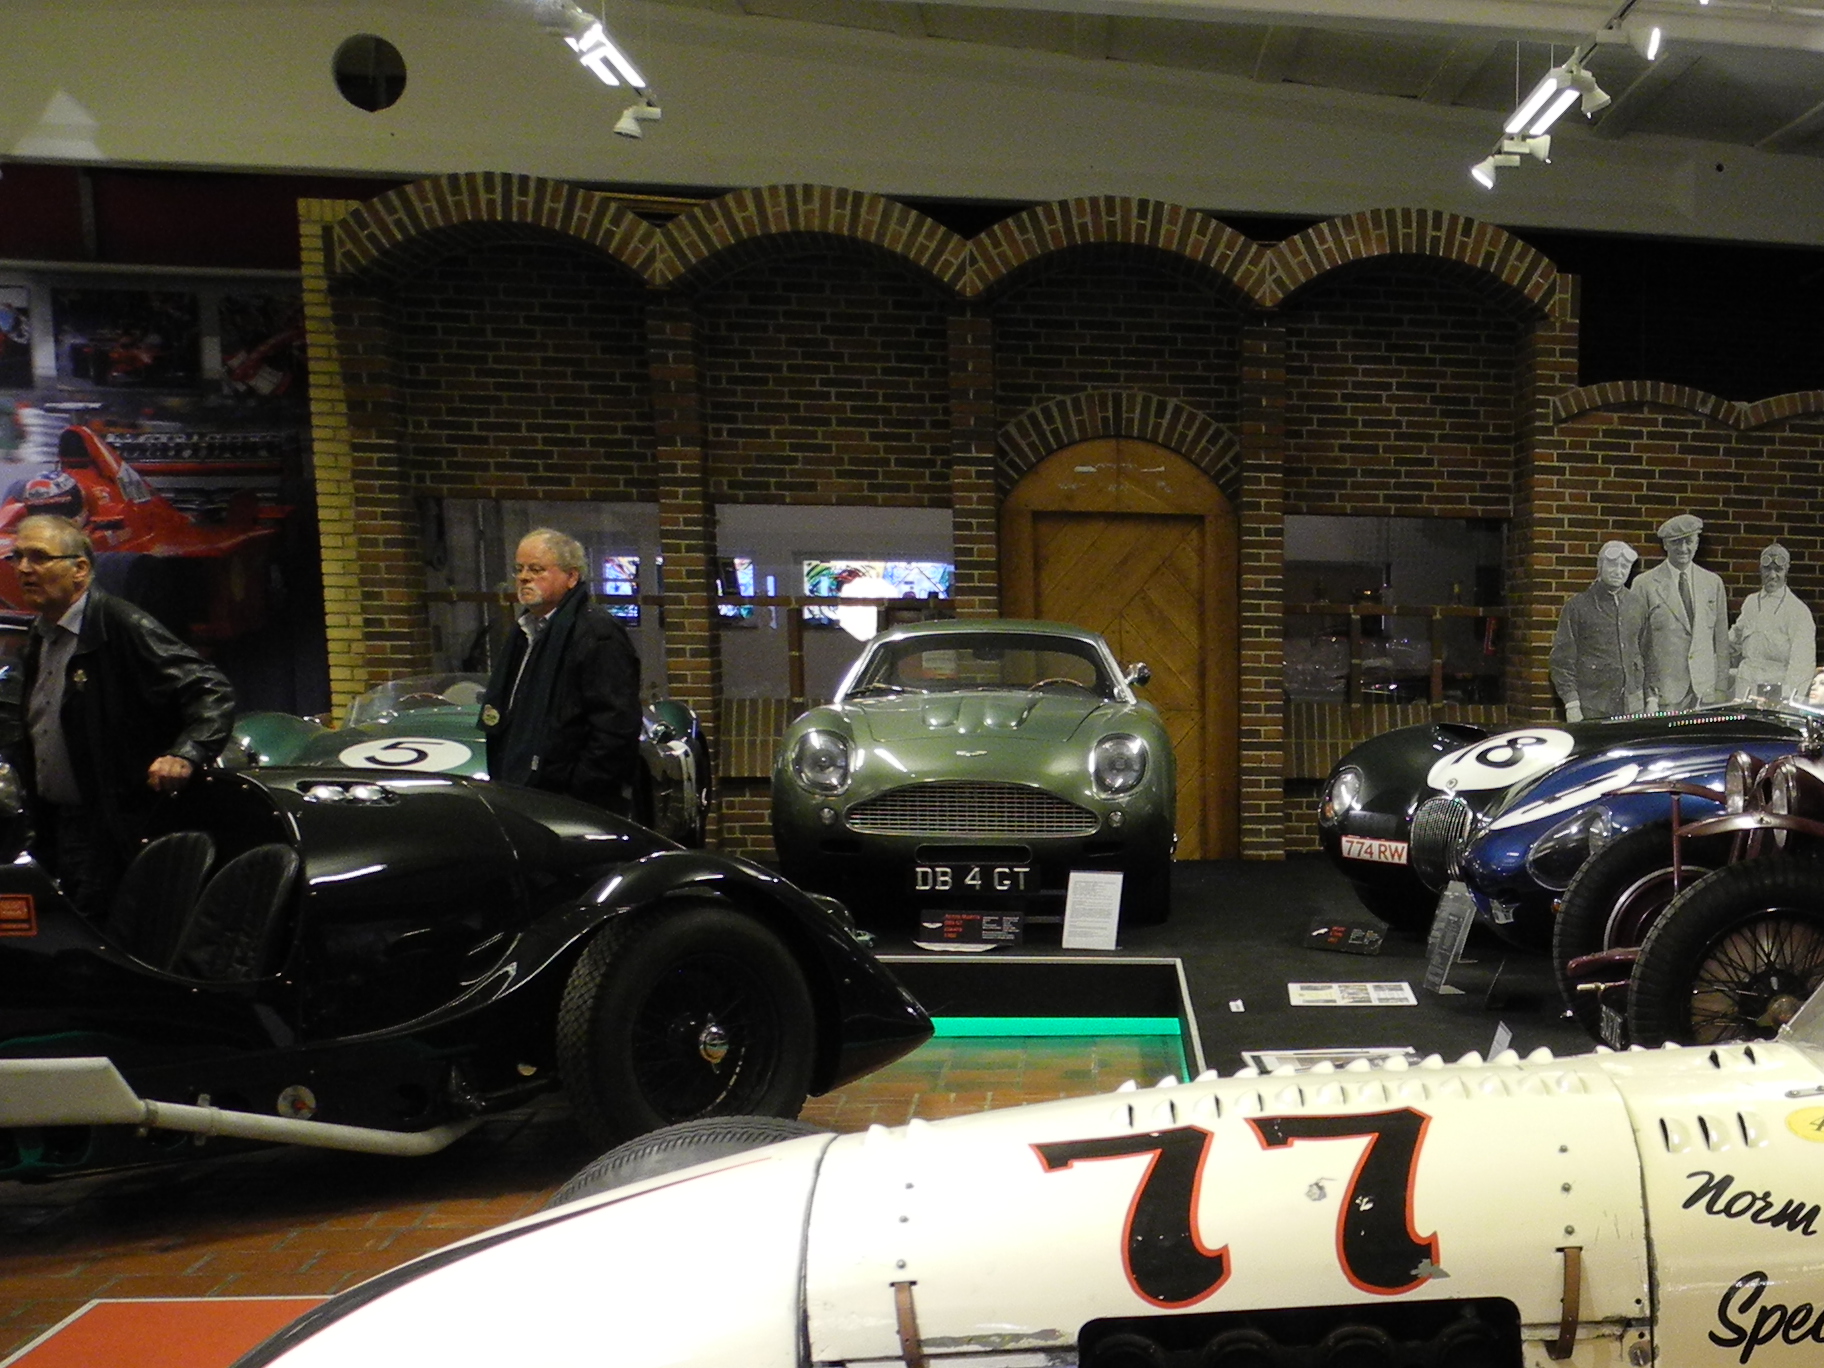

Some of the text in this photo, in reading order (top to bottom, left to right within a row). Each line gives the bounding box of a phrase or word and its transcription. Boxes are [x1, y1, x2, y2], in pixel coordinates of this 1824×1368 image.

[364, 741, 444, 767] 5
[1345, 840, 1406, 862] 774 RW
[915, 867, 1031, 891] DB 4 GT
[1028, 1106, 1441, 1310] 77
[1682, 1170, 1821, 1236] Norm
